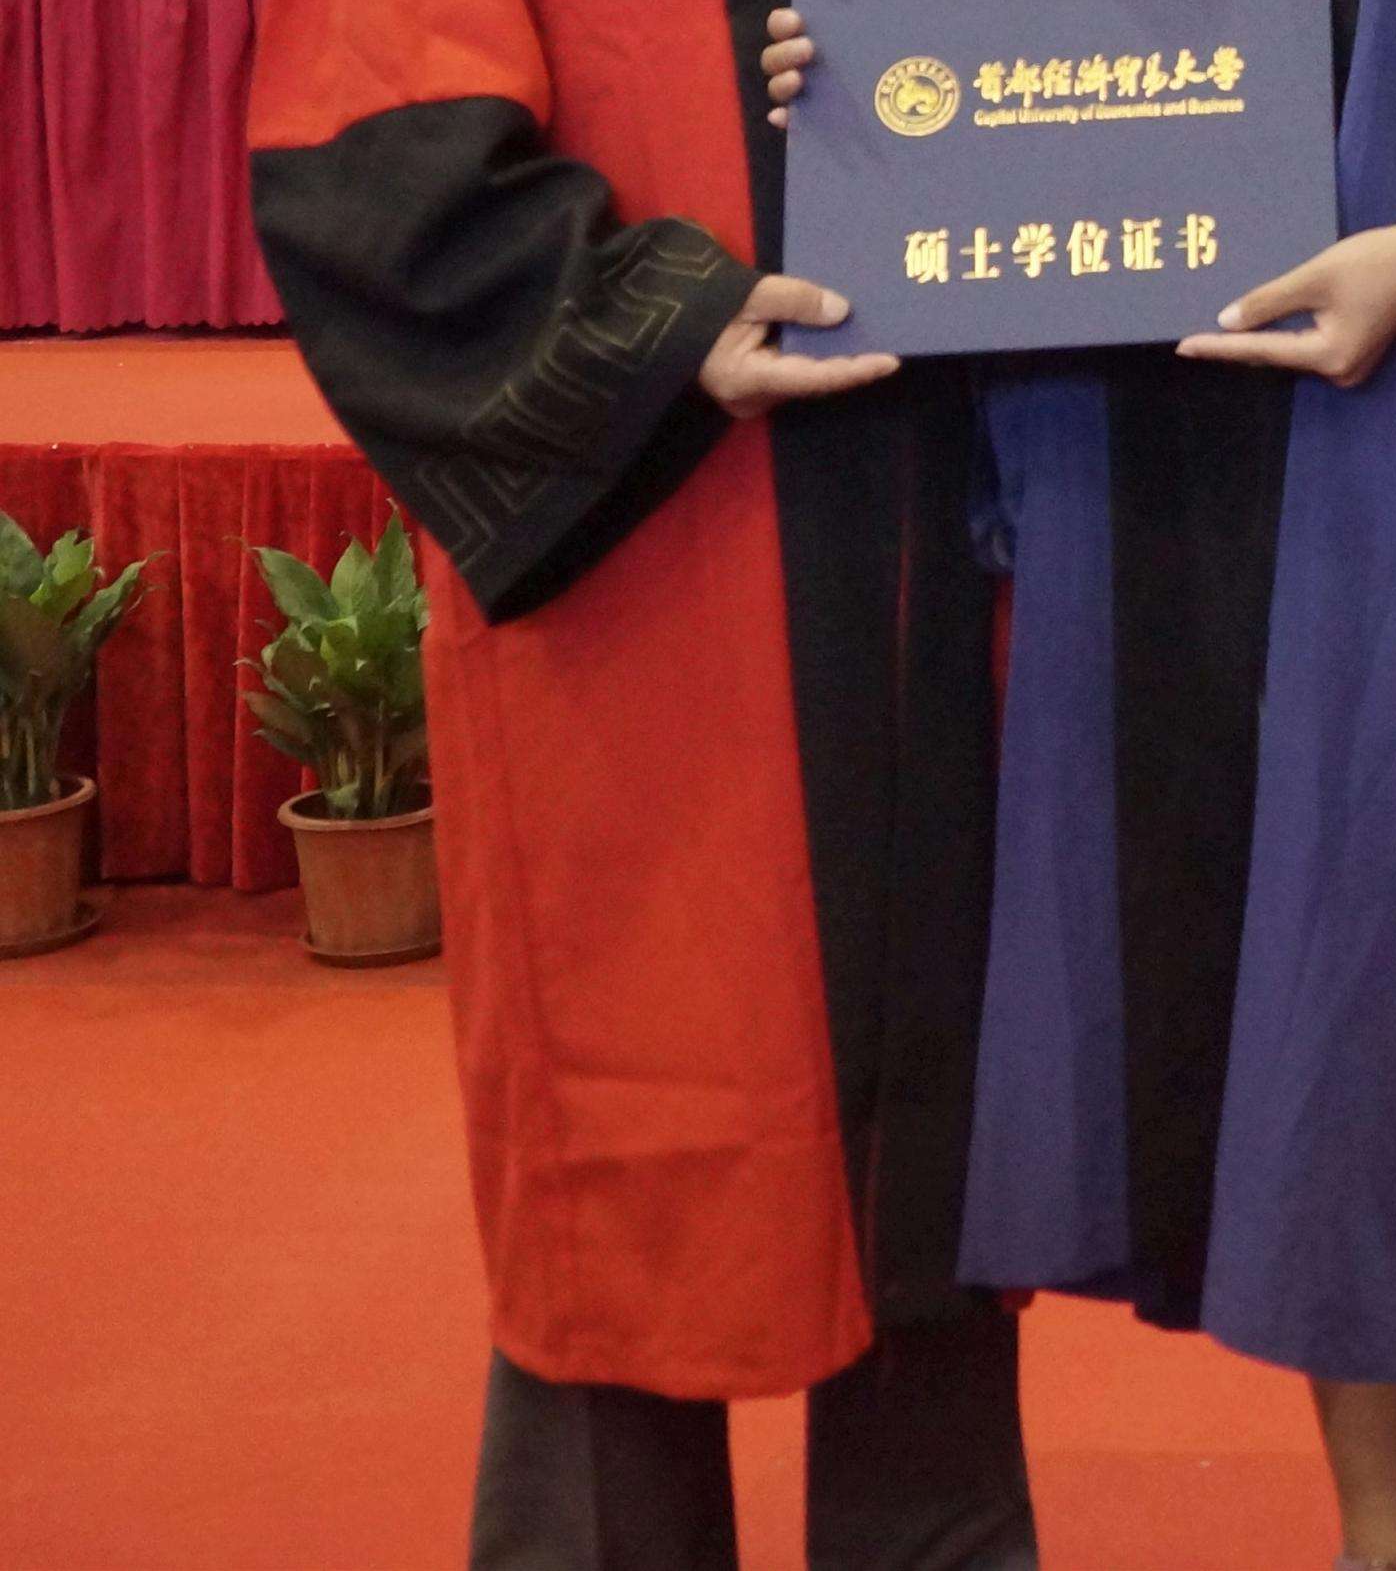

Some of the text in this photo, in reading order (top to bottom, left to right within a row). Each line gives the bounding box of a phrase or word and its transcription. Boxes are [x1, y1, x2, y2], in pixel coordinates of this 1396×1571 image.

[904, 213, 1219, 284] 硕士学位证书
